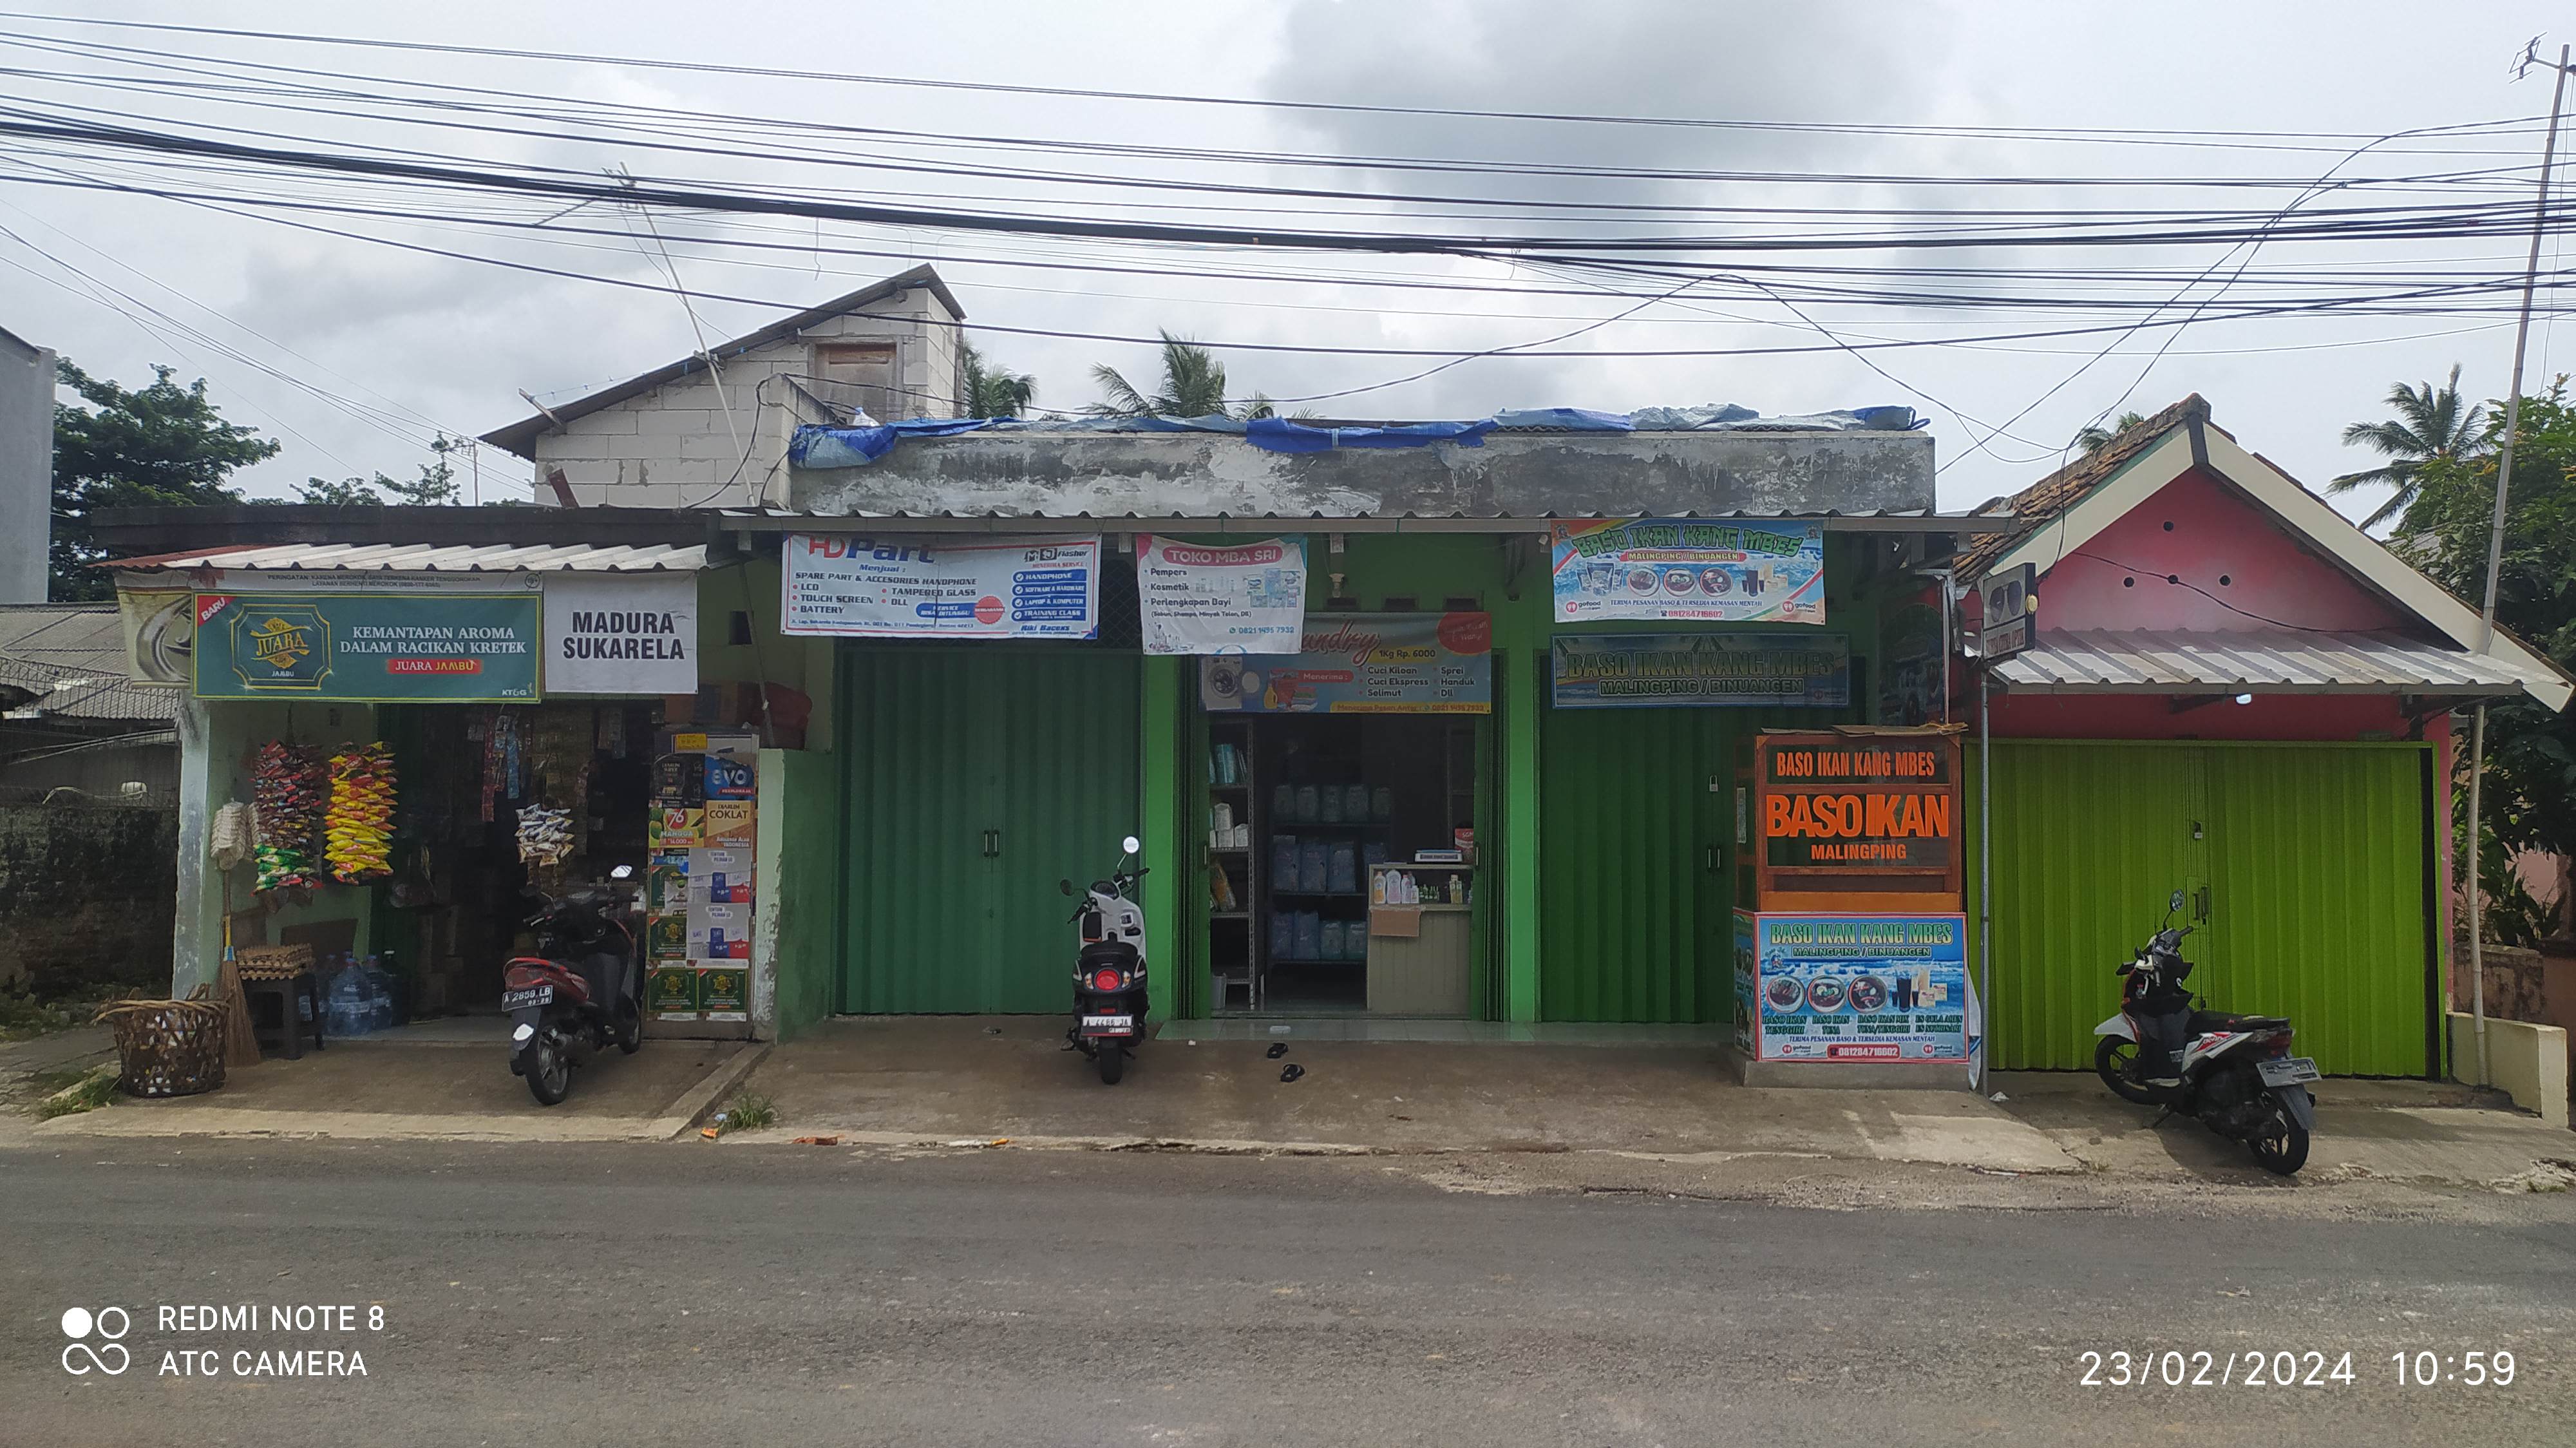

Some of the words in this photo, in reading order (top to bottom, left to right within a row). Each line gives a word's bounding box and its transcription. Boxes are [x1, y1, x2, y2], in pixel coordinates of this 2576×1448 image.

[1571, 529, 1630, 558] BASO
[1630, 525, 1681, 547] IKAN
[1684, 525, 1739, 549] KANG
[1743, 529, 1803, 557] MBES
[846, 538, 935, 564] Part
[1170, 550, 1211, 563] TOKO
[1216, 551, 1251, 563] MBA
[1255, 549, 1276, 560] SRI
[859, 564, 899, 573] Menjual
[1151, 568, 1187, 577] Pempers
[866, 575, 920, 584] ACCESORIES
[892, 587, 943, 596] TAMPERED
[800, 594, 833, 602] TOUCH
[836, 595, 874, 604] SCREEN
[1151, 598, 1209, 607] Perlengkapan
[1212, 598, 1231, 607] Bayi
[201, 597, 226, 621] BARU
[800, 605, 845, 613] BATTERY
[573, 612, 675, 634] MADURA
[353, 627, 453, 639] KEMANTAPAN
[458, 627, 515, 639] AROMA
[255, 632, 308, 656] JUARA
[340, 641, 392, 653] DALAM
[397, 642, 465, 653] RACIKAN
[470, 642, 527, 653] KRETEK
[563, 637, 685, 660] SUKARELA
[1379, 650, 1394, 659] 1Kg
[1396, 650, 1410, 659] Rp.
[395, 662, 433, 671] JUARA
[435, 662, 474, 671] JAMBU
[1567, 652, 1632, 678] BASO
[1636, 652, 1693, 677] IKAN
[1699, 651, 1765, 677] KANG
[1770, 652, 1835, 676] MBES
[1441, 667, 1464, 676] Sprei
[1367, 678, 1387, 686] Cuci
[1389, 678, 1429, 688] Ekspress
[1441, 678, 1475, 686] Handuk
[1601, 680, 1699, 694] MALINGPING
[1712, 679, 1803, 694] BINUANGEN
[1777, 752, 1813, 777] BASO
[1817, 752, 1850, 777] IKAN
[1854, 752, 1891, 777] KANG
[1895, 752, 1935, 777] MBES
[668, 808, 685, 826] 76
[709, 810, 748, 819] COKLAT
[1766, 794, 1863, 837] BASO
[1866, 794, 1949, 837] IKAN
[1811, 844, 1906, 860] MALINGPING
[1771, 924, 1814, 944] BASO
[1817, 923, 1856, 944] IKAN
[1861, 923, 1904, 944] KANG
[1908, 923, 1953, 944] MBES
[1793, 948, 1859, 957] MALINGPING
[1868, 948, 1931, 956] BINUANGEN
[1763, 1015, 1785, 1024] BASO
